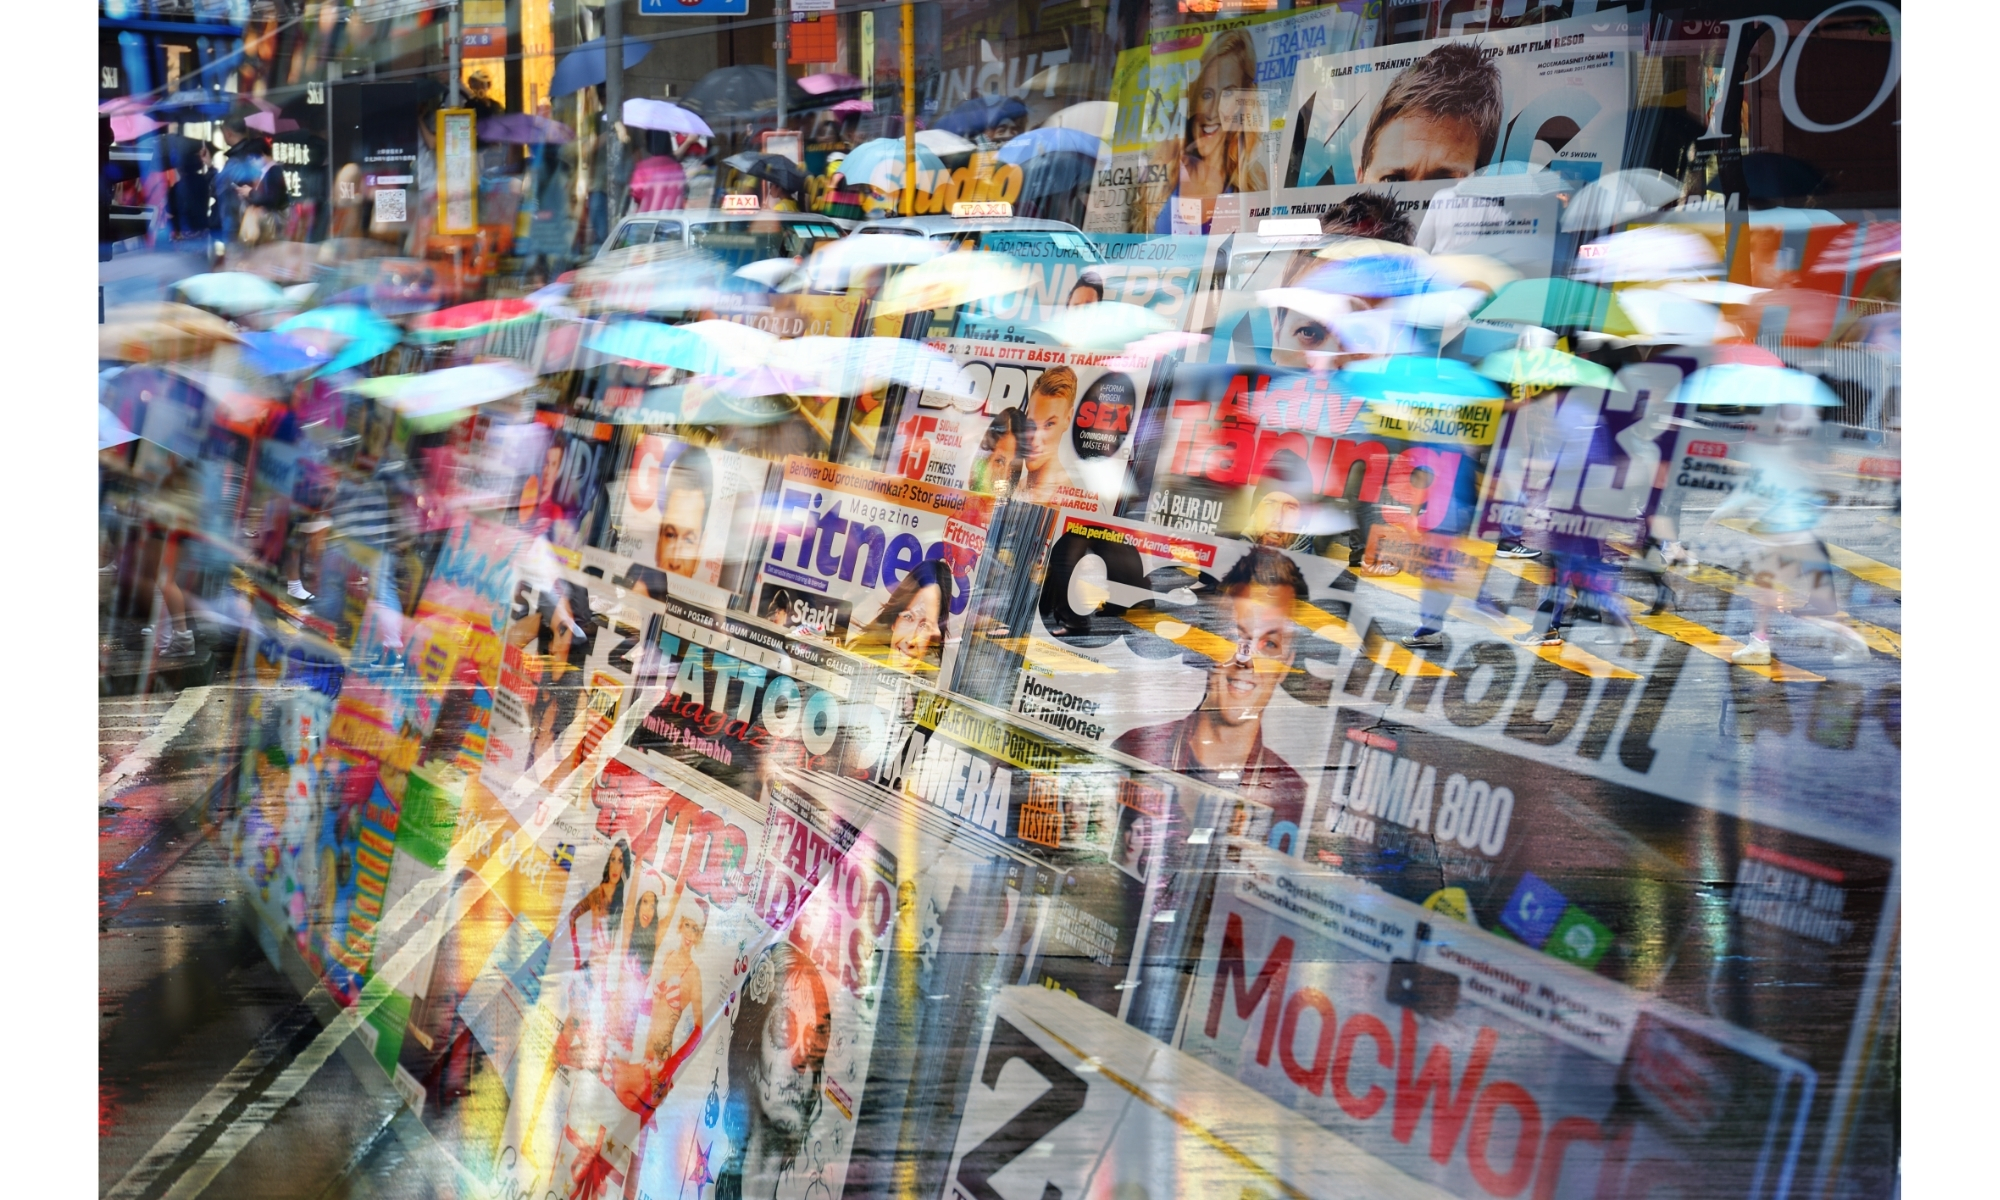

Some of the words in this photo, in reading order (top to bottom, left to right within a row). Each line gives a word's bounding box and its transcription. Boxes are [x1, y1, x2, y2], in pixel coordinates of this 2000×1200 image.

[465, 35, 477, 45] 2X
[1268, 24, 1327, 58] TRÄNA
[1481, 47, 1504, 60] TIPS
[1506, 43, 1527, 56] MAT
[1529, 38, 1552, 53] FILM
[1554, 33, 1585, 49] RESOR
[1331, 66, 1353, 78] BILAR
[1354, 63, 1373, 75] STIL
[1375, 57, 1411, 72] TRÄNING
[1697, 0, 1900, 140] PO
[1560, 150, 1569, 158] OF
[1570, 151, 1598, 159] SWEDEN
[868, 150, 1024, 216] Studio
[729, 197, 757, 207] TAXI
[961, 204, 1007, 216] TAXI
[1249, 207, 1271, 218] BILAR
[1272, 205, 1289, 216] STIL
[1291, 202, 1326, 216] TRÄNING
[990, 240, 1043, 259] LÖPARENS
[1043, 241, 1080, 259] STORA
[1082, 242, 1147, 261] PRYLGUIDE
[1148, 243, 1178, 261] 2012
[1584, 246, 1609, 257] TAX
[974, 345, 995, 358] TILL
[999, 347, 1026, 361] DITT
[1027, 347, 1066, 364] BÄSTA
[1076, 401, 1132, 432] SEX
[1214, 374, 1366, 435] Aktiv
[1394, 398, 1437, 418] TOPPA
[1439, 403, 1492, 422] FORMEN
[935, 433, 962, 448] SPECIAL
[1379, 414, 1405, 430] TILL
[1405, 417, 1488, 440] VASALOPPET
[897, 413, 939, 481] 15
[1081, 438, 1102, 450] MÅSTE
[1102, 441, 1111, 452] HA
[927, 460, 956, 476] FITNESS
[1676, 472, 1737, 494] Galaxy
[789, 460, 822, 480] Behöver
[821, 467, 836, 483] DU
[835, 471, 909, 500] proteindrinkar?
[909, 486, 933, 505] Stor
[933, 493, 966, 512] guide!
[1055, 484, 1099, 502] ANGELICA
[849, 497, 920, 529] Magazine
[1057, 499, 1098, 513] MARCUS
[1150, 490, 1170, 514] SÅ
[1170, 493, 1201, 519] BLIR
[1201, 501, 1223, 524] DU
[943, 520, 985, 552] Fitness
[1066, 521, 1088, 536] Plåta
[1087, 527, 1125, 545] perfekt!
[1124, 533, 1142, 547] Stor
[1143, 539, 1211, 563] kameraspecial
[791, 599, 838, 634] Stark!
[687, 608, 714, 627] POSTER
[720, 623, 749, 638] ALBUM
[749, 632, 784, 650] MUSEUM
[790, 645, 818, 663] FORUM
[826, 657, 855, 675] GALLERI
[658, 631, 840, 756] TATTOO
[1022, 674, 1101, 717] Hormoner
[934, 699, 986, 745] OBJEKTIV
[1018, 697, 1040, 717] för
[1039, 704, 1105, 742] miljoner
[682, 728, 733, 767] Samohin
[883, 723, 1013, 838] KAMERA
[1331, 740, 1438, 834] LUMIA
[1435, 772, 1516, 857] 800
[1022, 807, 1059, 846] TESTER
[727, 864, 745, 892] MAG
[770, 807, 892, 939] TATTOO
[1204, 911, 1690, 1200] MacWor
